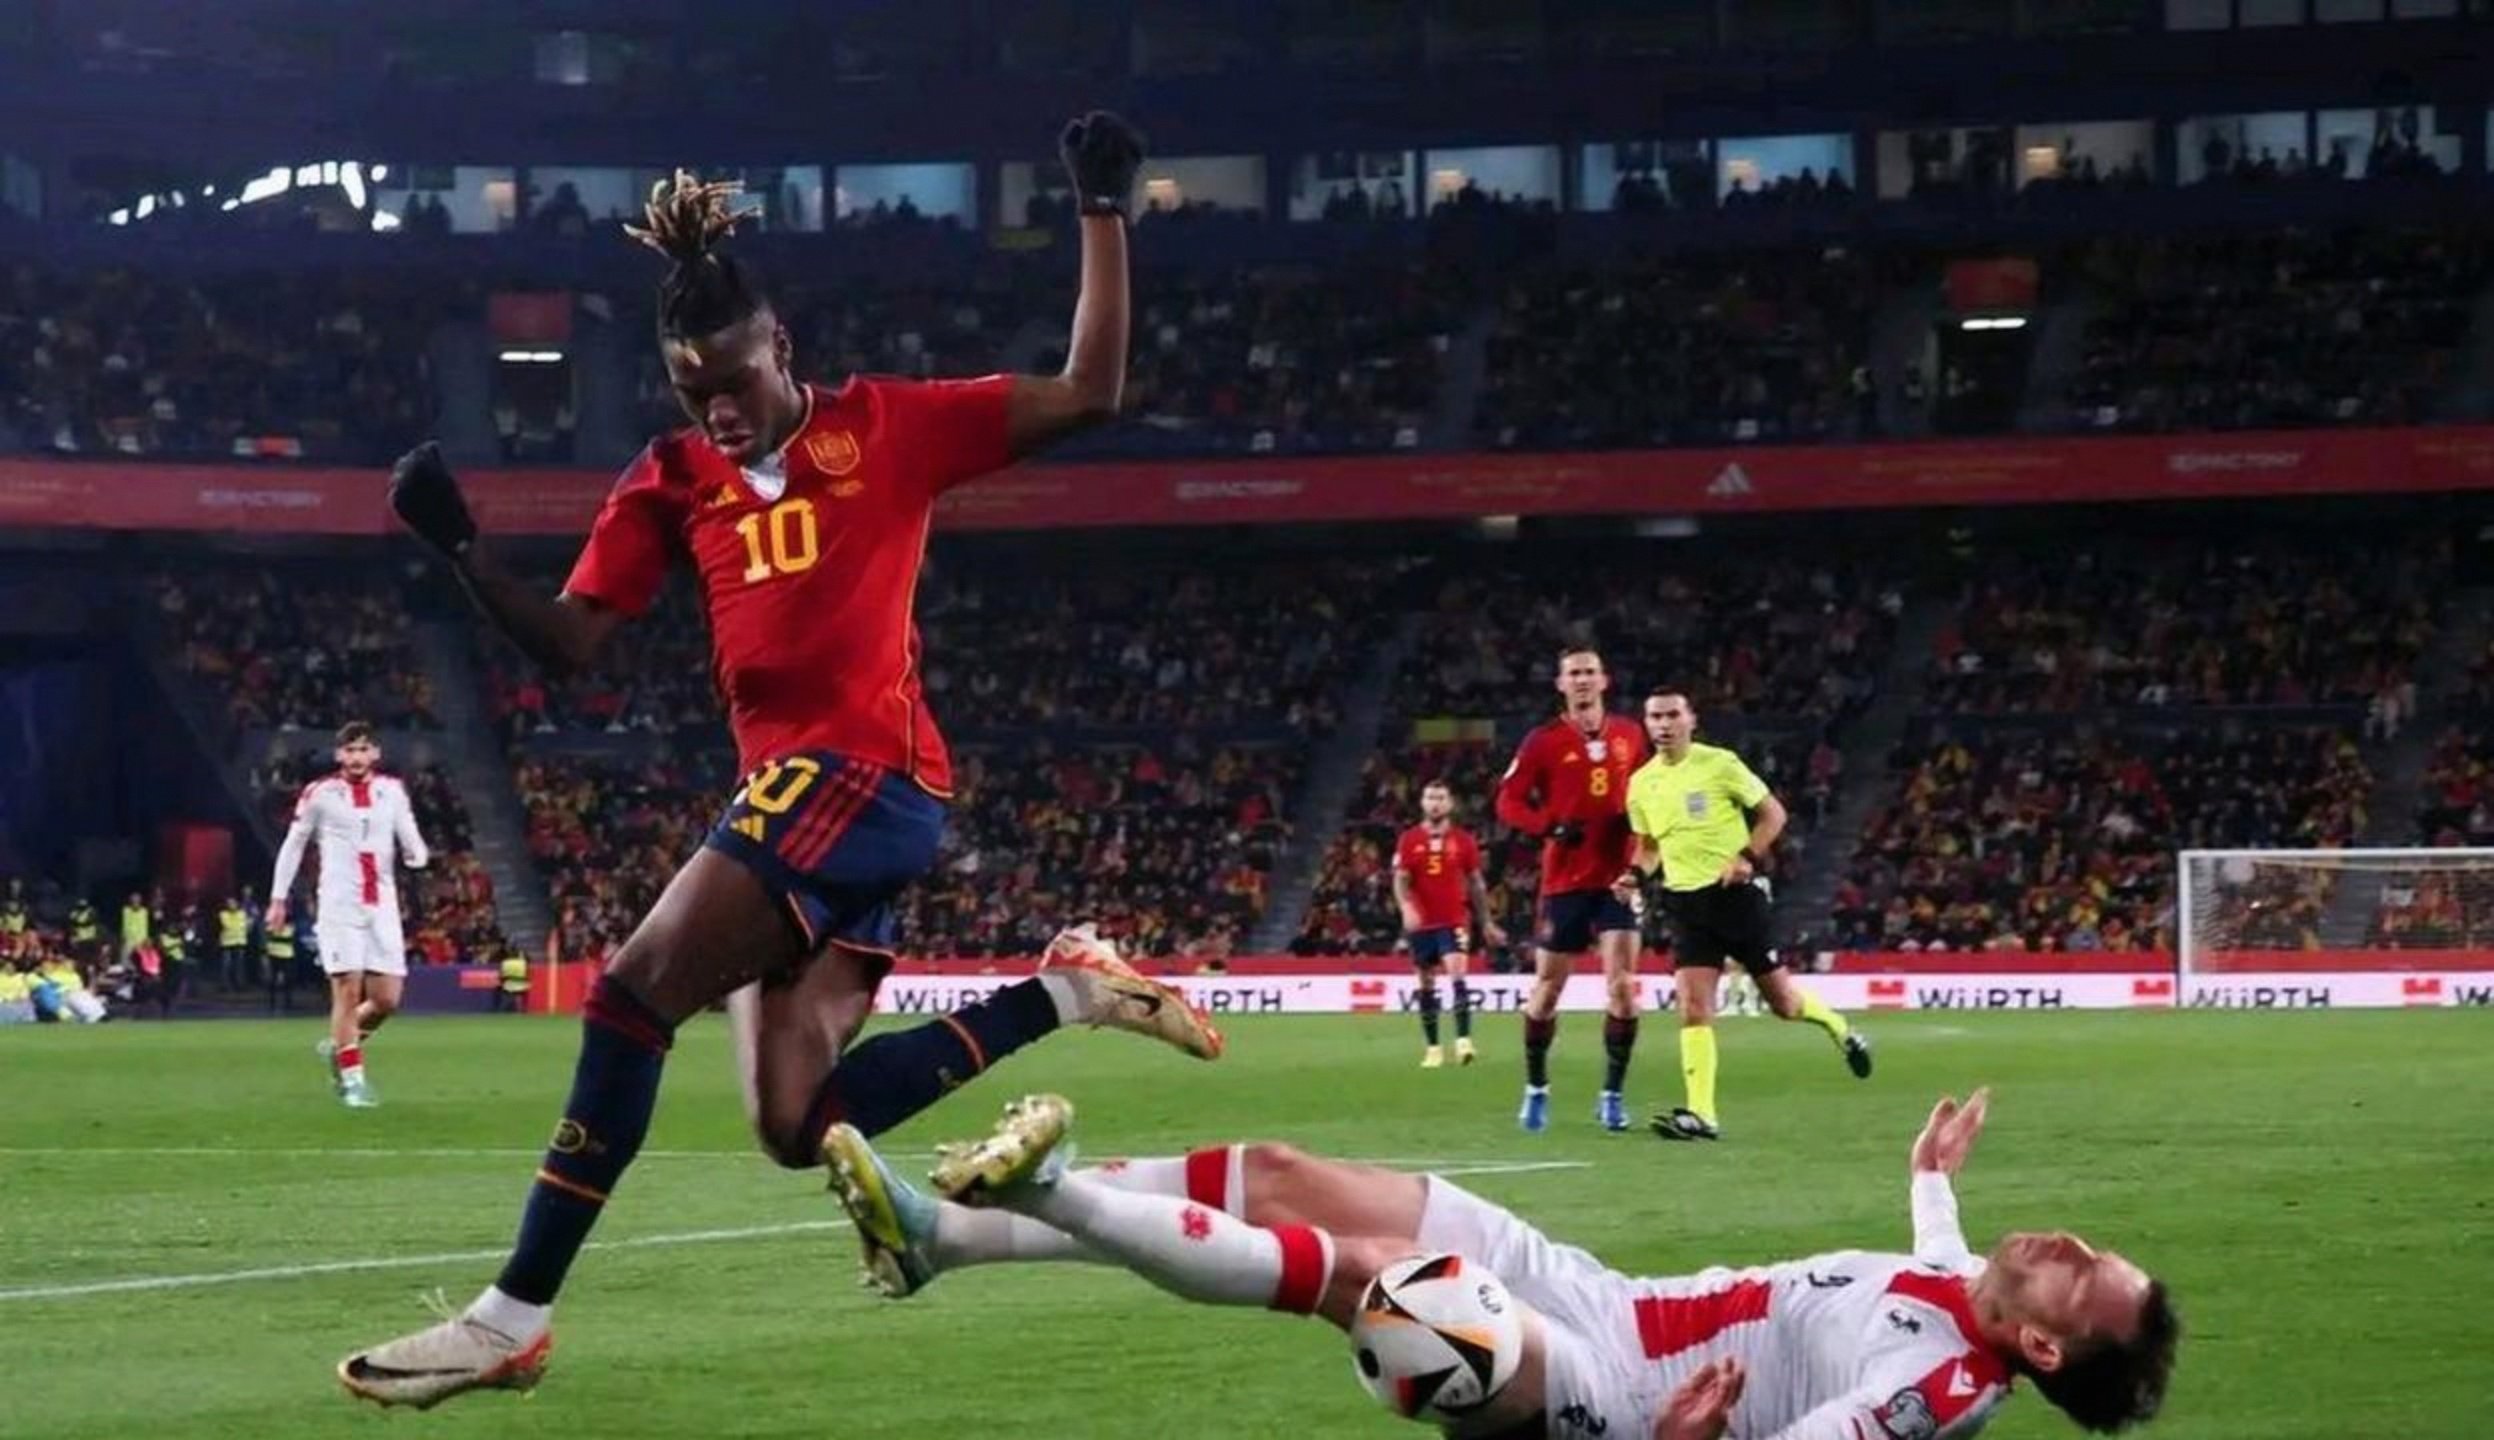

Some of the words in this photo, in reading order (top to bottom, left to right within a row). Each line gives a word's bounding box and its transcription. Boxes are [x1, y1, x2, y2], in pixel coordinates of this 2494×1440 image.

[735, 498, 818, 583] 10
[1589, 767, 1609, 797] 8
[1426, 855, 1441, 876] 5
[893, 988, 996, 1013] WÜR
[1183, 988, 1283, 1013] ÜRTH
